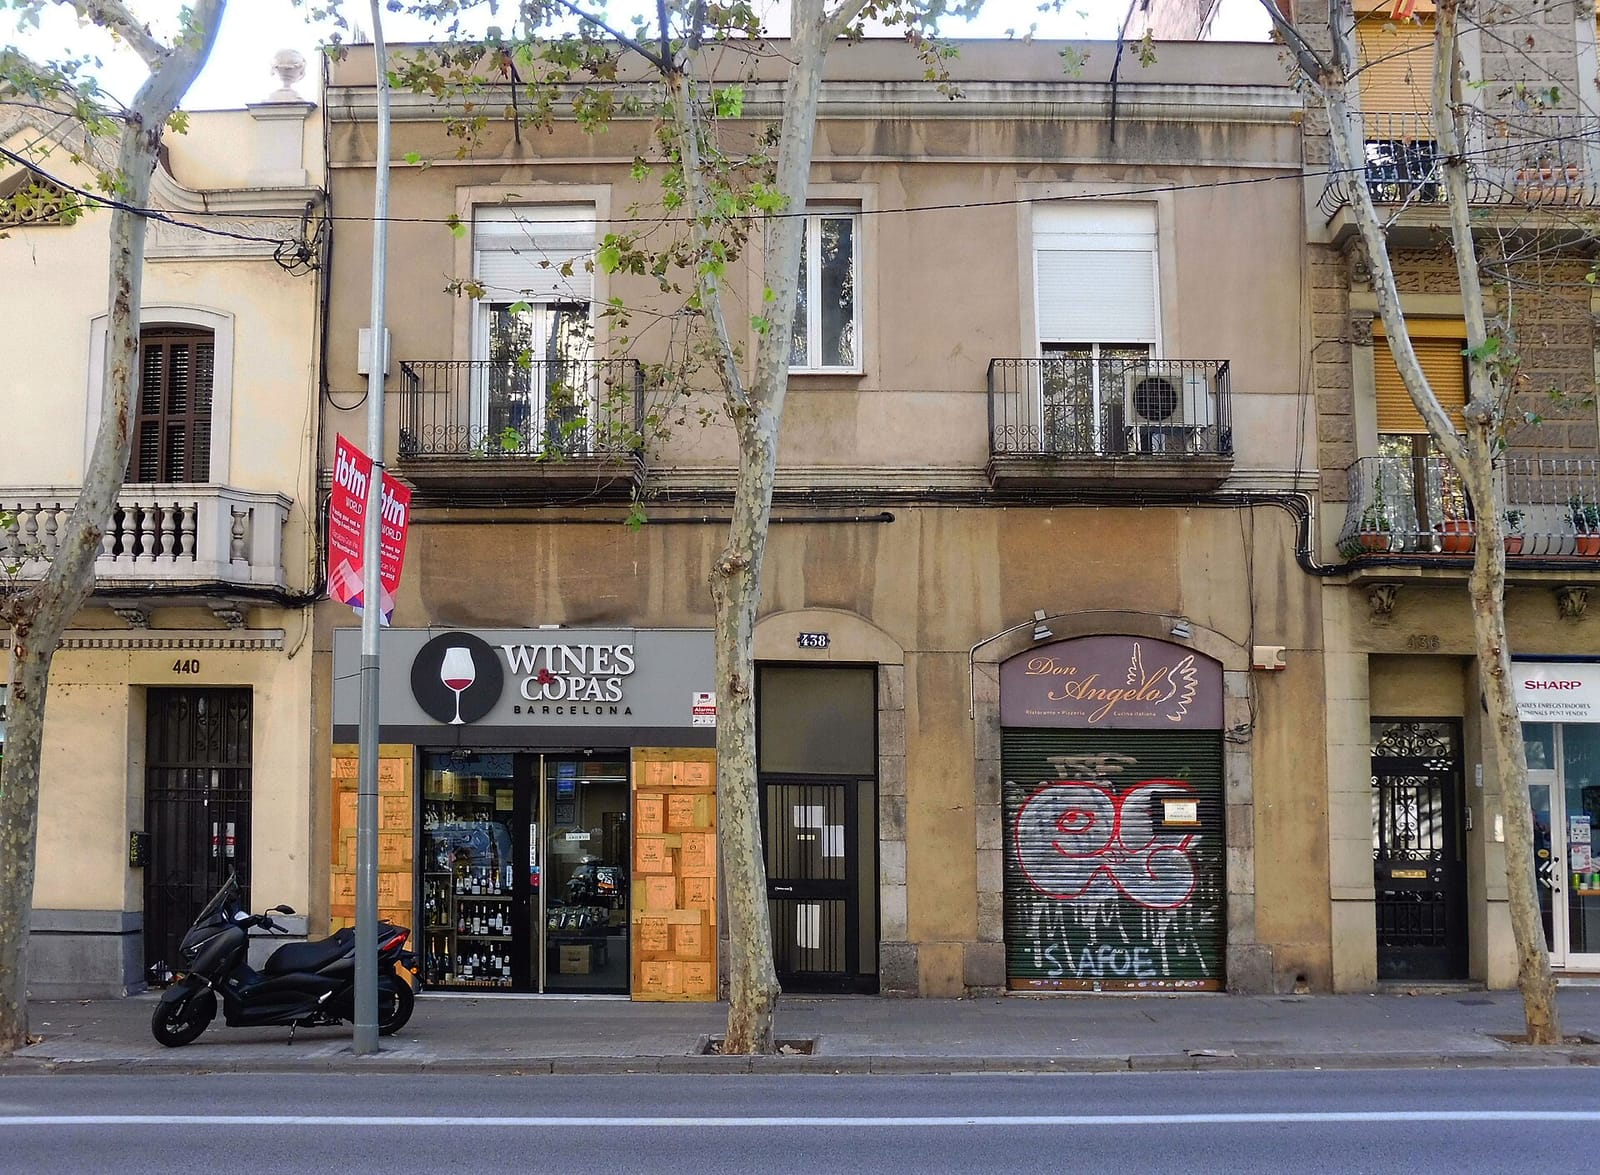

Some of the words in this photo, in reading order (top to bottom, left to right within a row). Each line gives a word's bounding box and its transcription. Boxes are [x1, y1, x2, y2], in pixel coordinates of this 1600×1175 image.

[336, 447, 367, 500] ibtm
[345, 495, 363, 515] WORLD
[381, 482, 405, 528] btm
[800, 634, 826, 648] 438
[1407, 633, 1440, 650] 436
[172, 658, 200, 674] 440
[500, 644, 635, 675] WINES
[1025, 656, 1077, 676] Don
[520, 676, 623, 702] COPAS
[1048, 666, 1168, 724] Angelo
[1524, 680, 1582, 690] SHARP
[513, 705, 632, 715] BARCELONA
